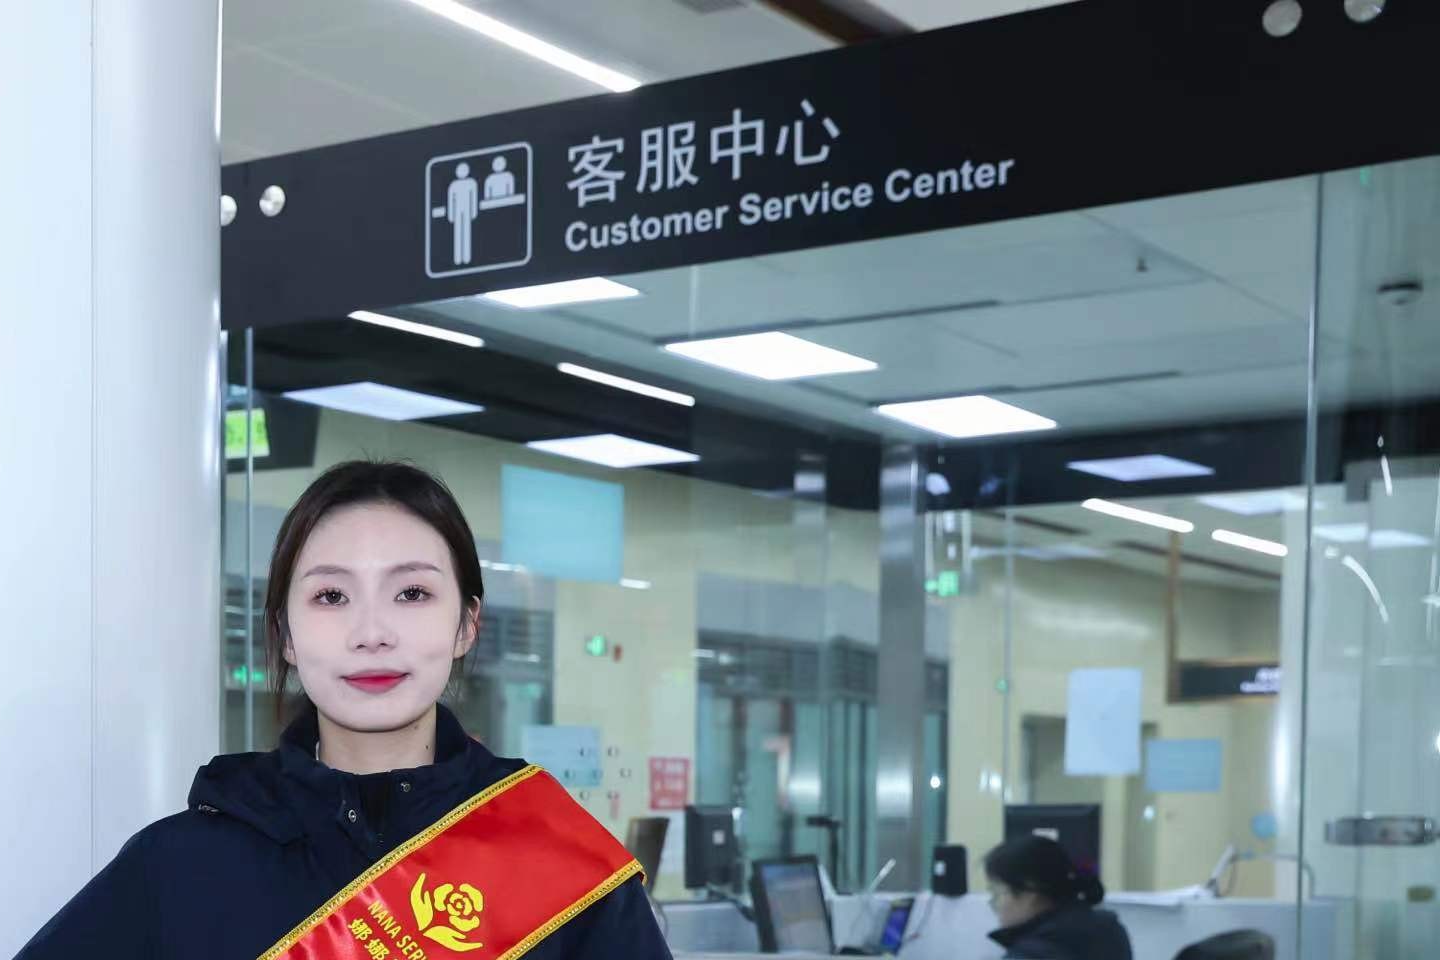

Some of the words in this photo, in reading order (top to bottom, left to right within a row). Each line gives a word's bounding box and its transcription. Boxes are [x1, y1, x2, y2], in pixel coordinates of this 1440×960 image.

[566, 99, 840, 208] 客服中心
[564, 205, 729, 251] Customer
[738, 181, 874, 226] Service
[884, 158, 1014, 203] Center
[367, 899, 402, 939] NANA
